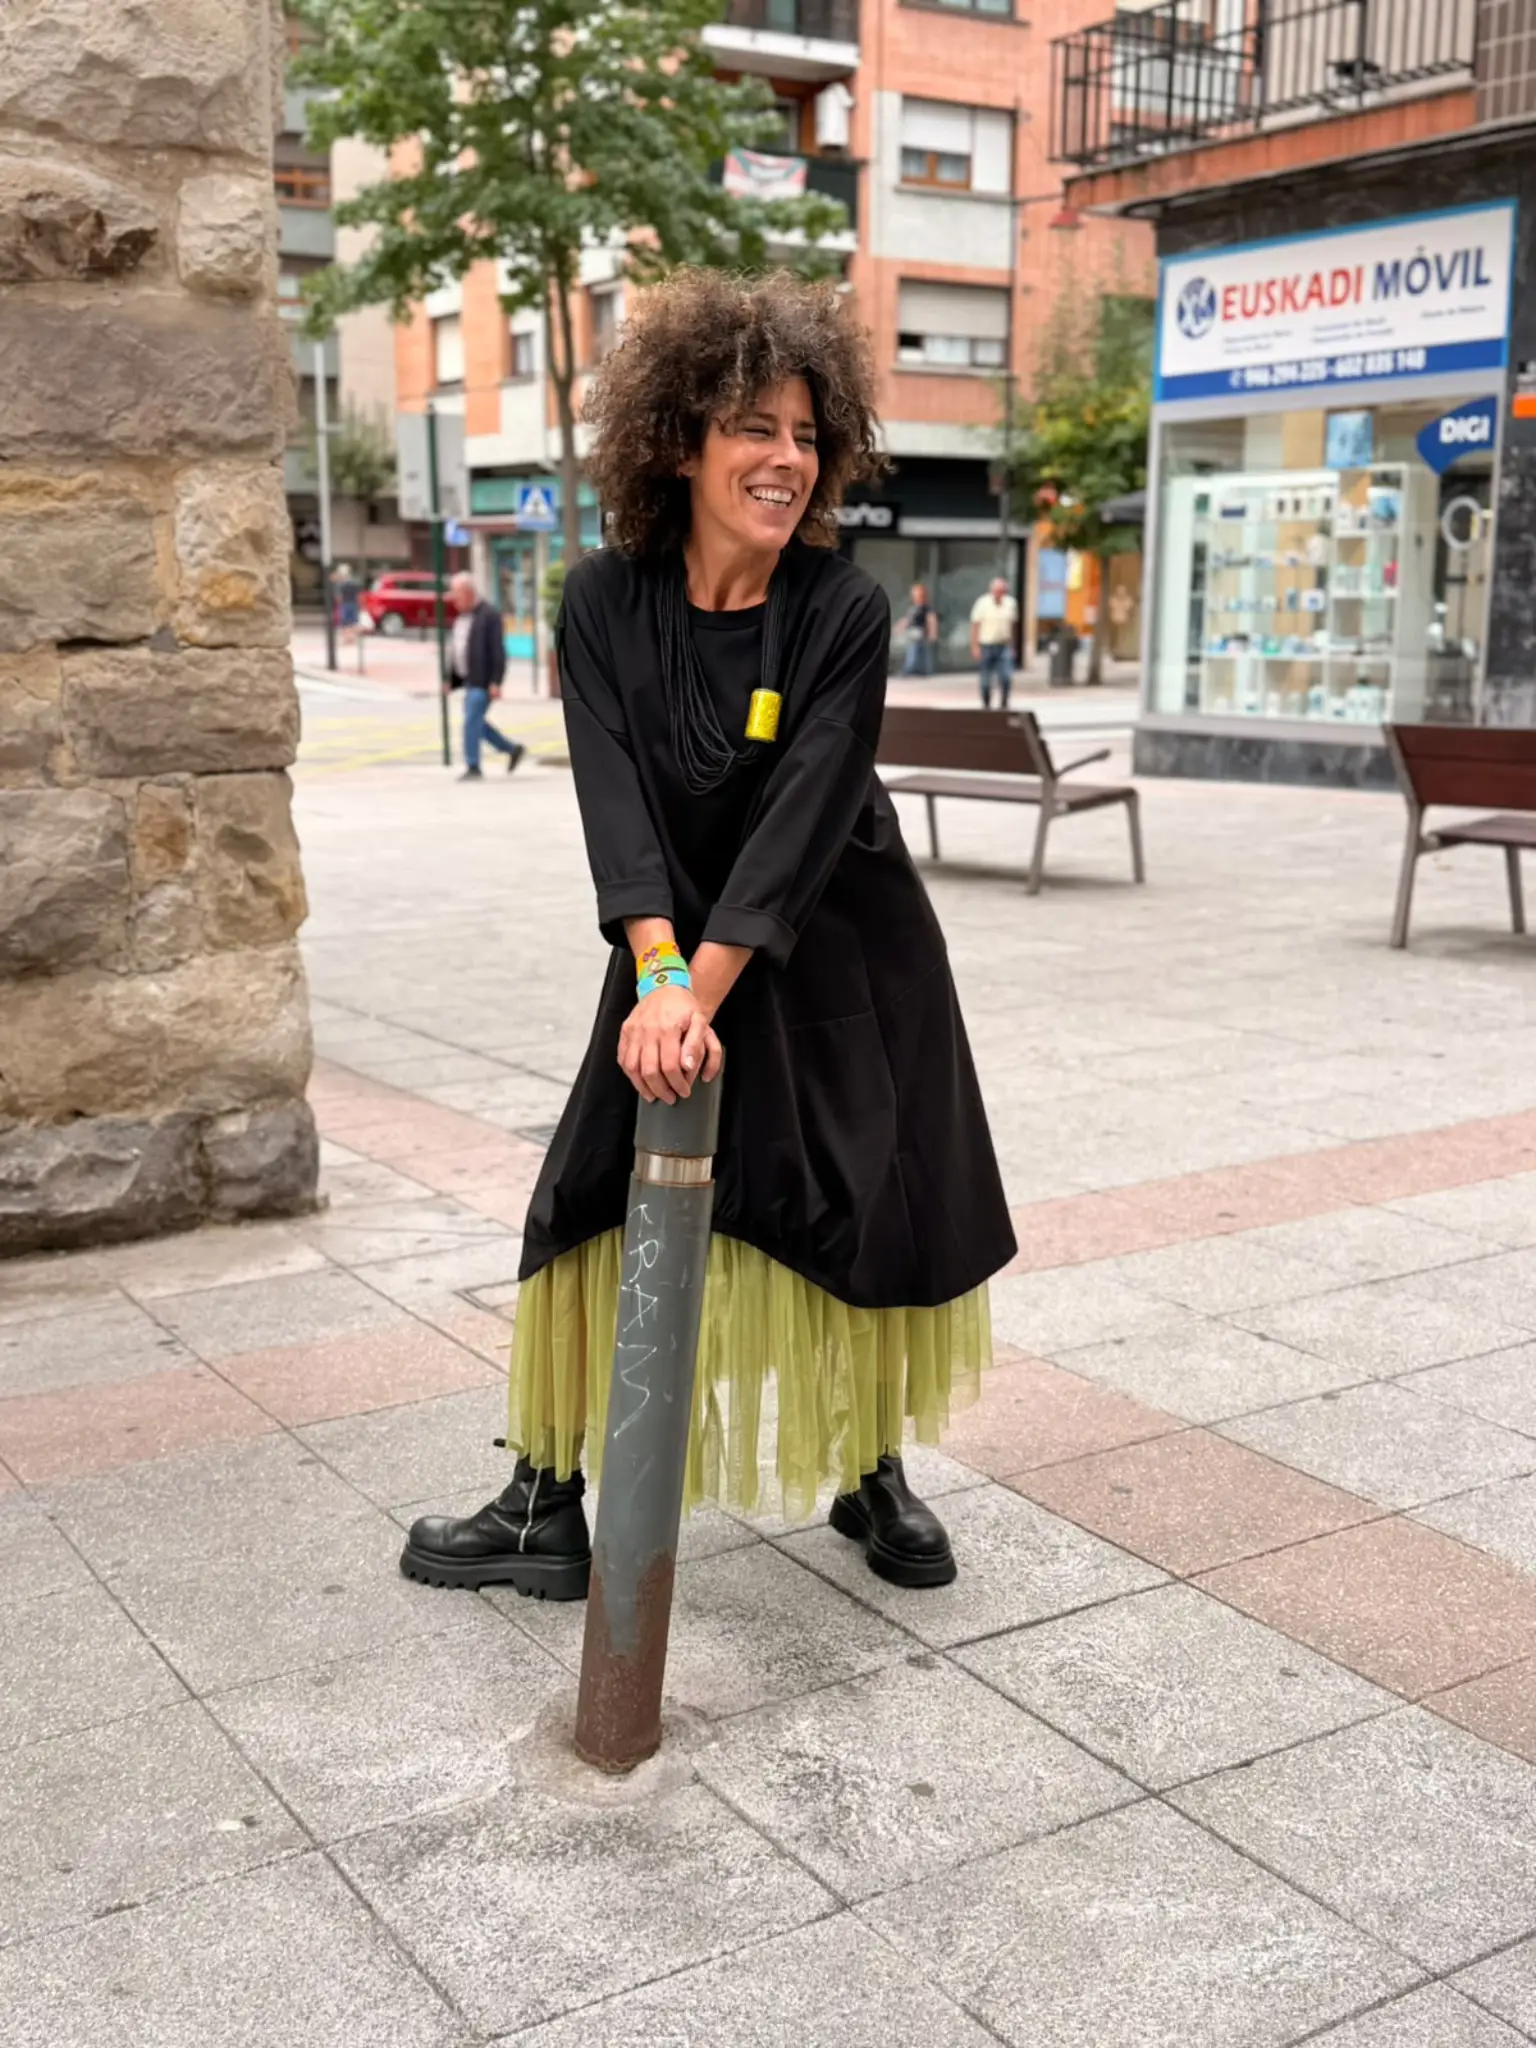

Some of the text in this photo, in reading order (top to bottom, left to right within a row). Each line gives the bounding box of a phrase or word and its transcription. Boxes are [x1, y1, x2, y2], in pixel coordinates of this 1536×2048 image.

[1222, 266, 1365, 321] EUSKADI
[1373, 246, 1492, 301] MÓVIL
[1440, 415, 1491, 444] DIGI
